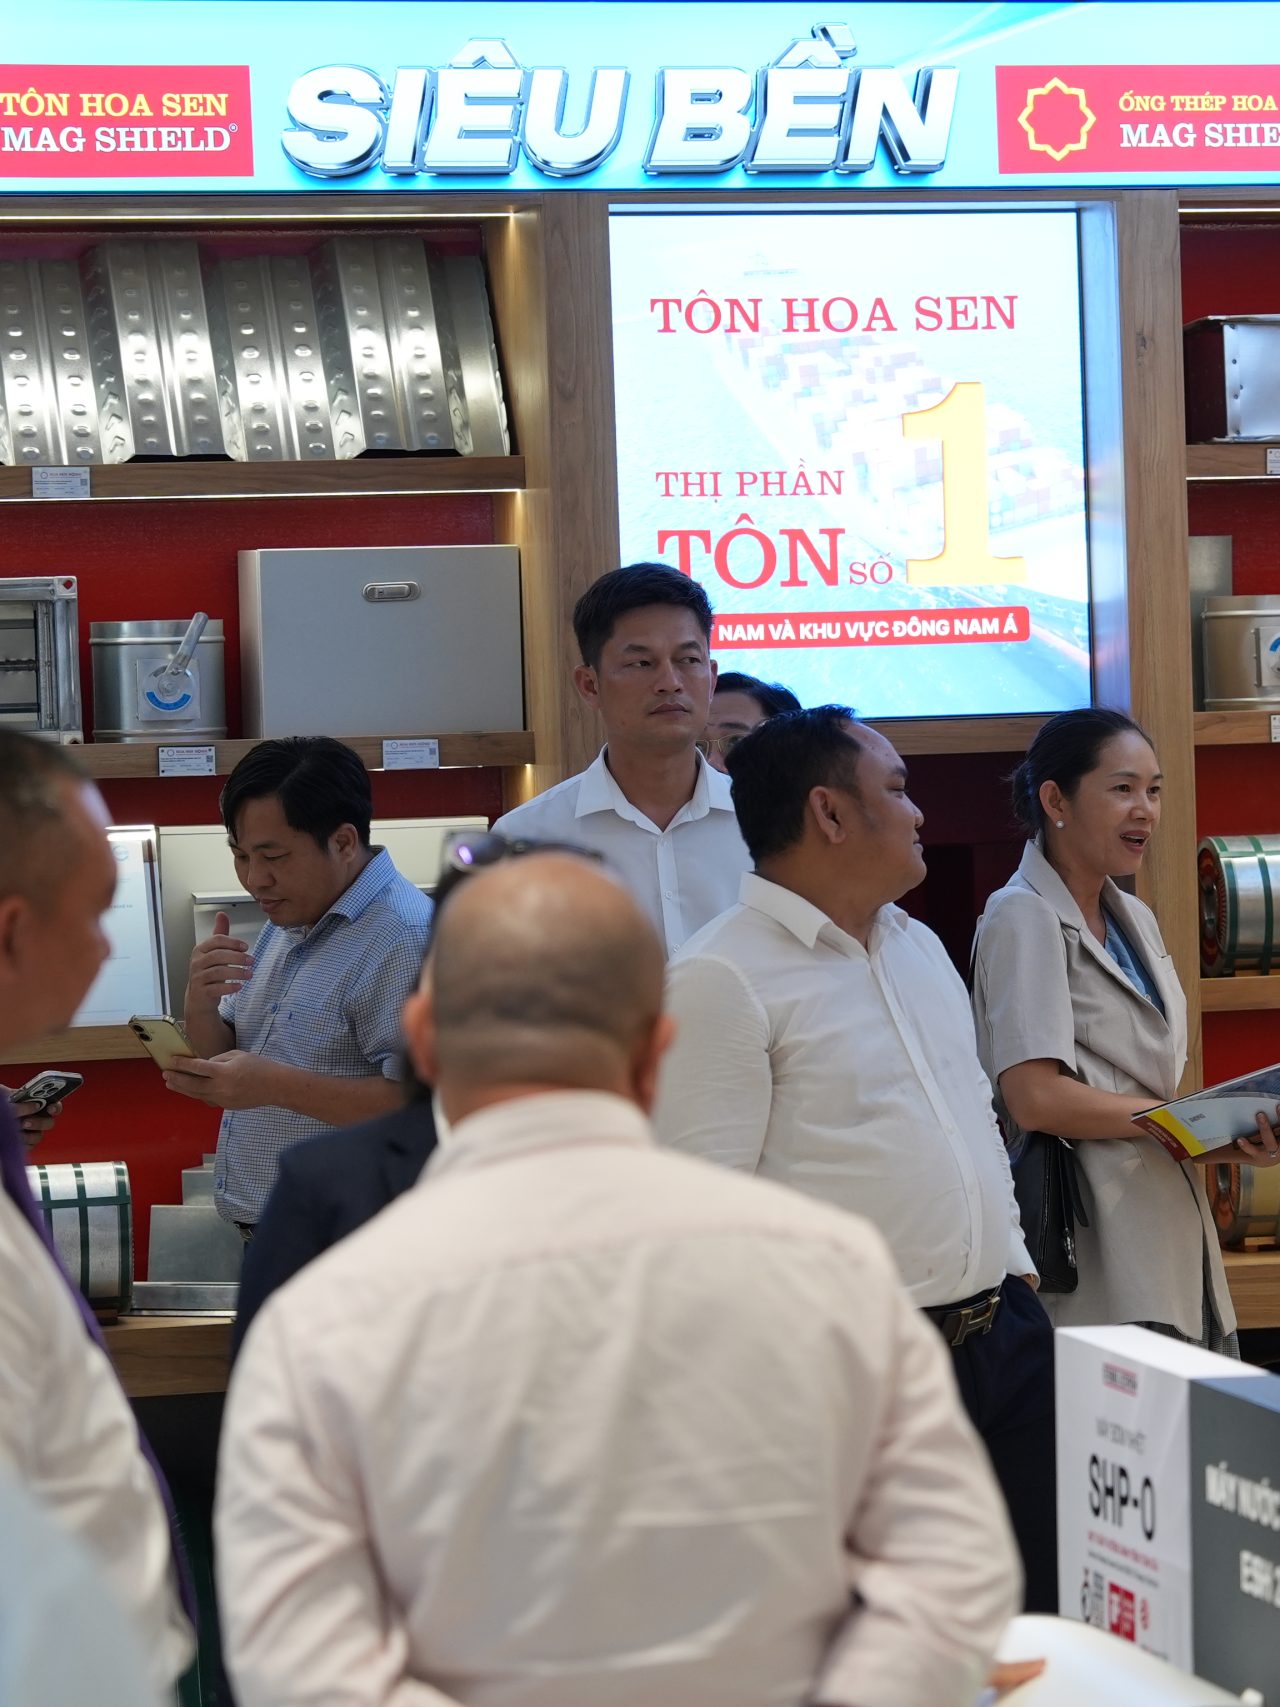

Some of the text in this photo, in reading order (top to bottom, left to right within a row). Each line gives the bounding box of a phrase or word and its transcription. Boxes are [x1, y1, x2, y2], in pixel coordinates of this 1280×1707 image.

[0, 87, 228, 118] TÔN HOA SEN
[281, 22, 960, 178] SIÊU BỀN
[1118, 90, 1166, 113] ỐNG
[1170, 91, 1227, 112] THÉP
[1232, 95, 1279, 112] HOA
[1, 126, 85, 153] MAG
[1119, 122, 1197, 148] MAG
[650, 288, 1019, 334] TÔN HOA SEN
[655, 457, 846, 503] THỊ PHẦN
[657, 381, 1028, 590] TÔN SỐ 1
[718, 610, 1019, 642] NAM VÀ KHU VỰC ĐÔNG NAM Á
